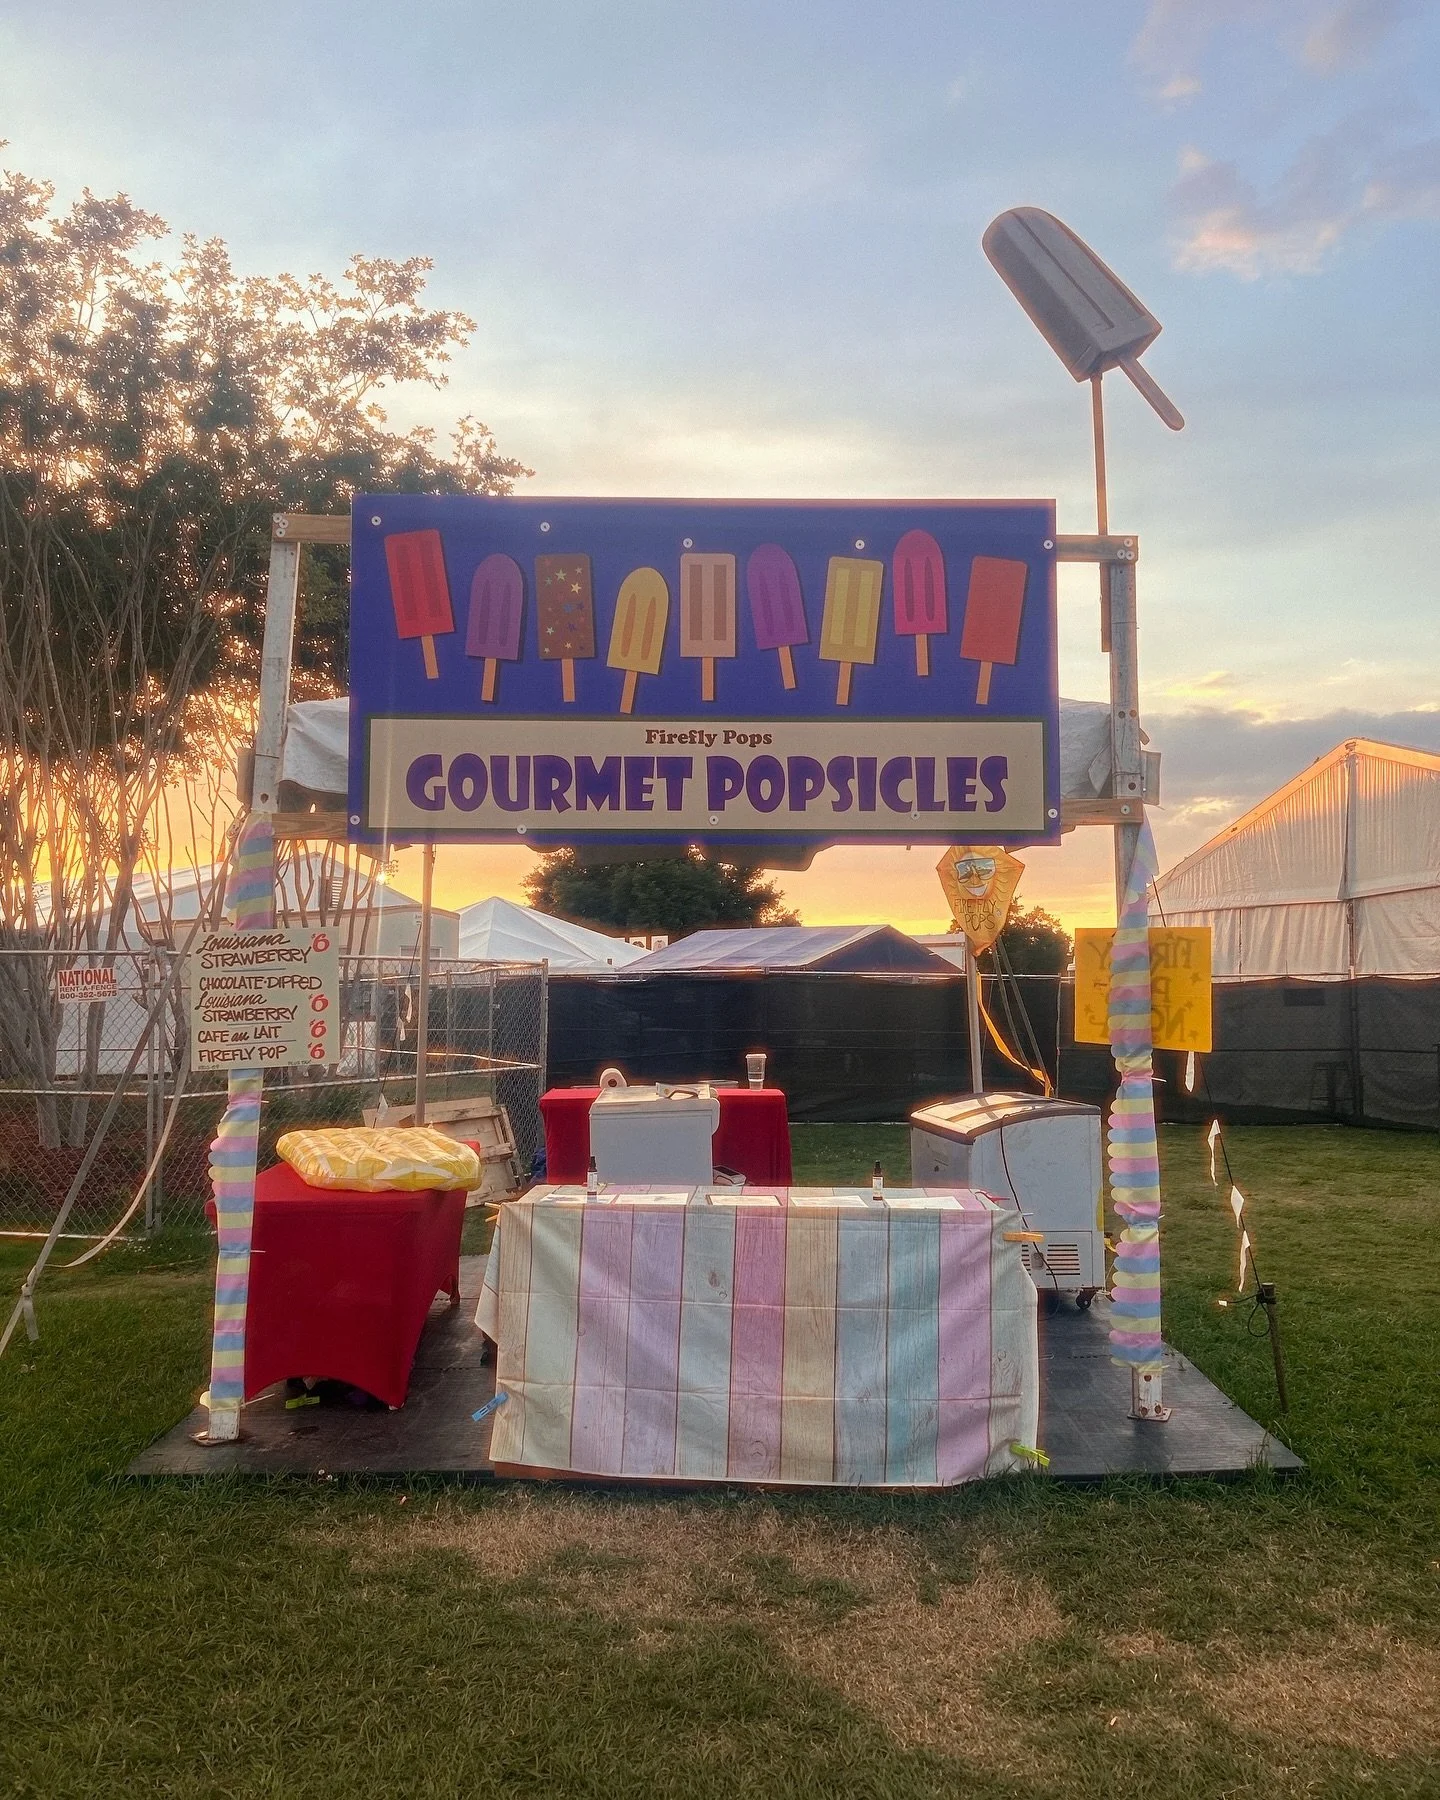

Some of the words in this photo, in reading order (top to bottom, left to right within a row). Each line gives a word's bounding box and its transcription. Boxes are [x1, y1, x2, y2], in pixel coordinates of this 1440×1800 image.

[645, 729, 718, 749] Firefly
[722, 729, 773, 749] Pops
[405, 752, 693, 813] GOURMET
[705, 753, 1010, 813] POPSICLES
[964, 913, 996, 931] POPS
[196, 933, 291, 954] Louisiana
[201, 946, 312, 969] STRAWBERRY
[58, 968, 117, 987] NATIONAL
[59, 984, 118, 993] RENT-A-FENCE
[195, 991, 268, 1010] Louisiana
[202, 1005, 298, 1022] STRAWBERRY
[198, 1030, 230, 1043] CAFE
[253, 1025, 283, 1039] LAIT
[198, 1047, 257, 1063] FIREFLY
[258, 1045, 288, 1059] POP
